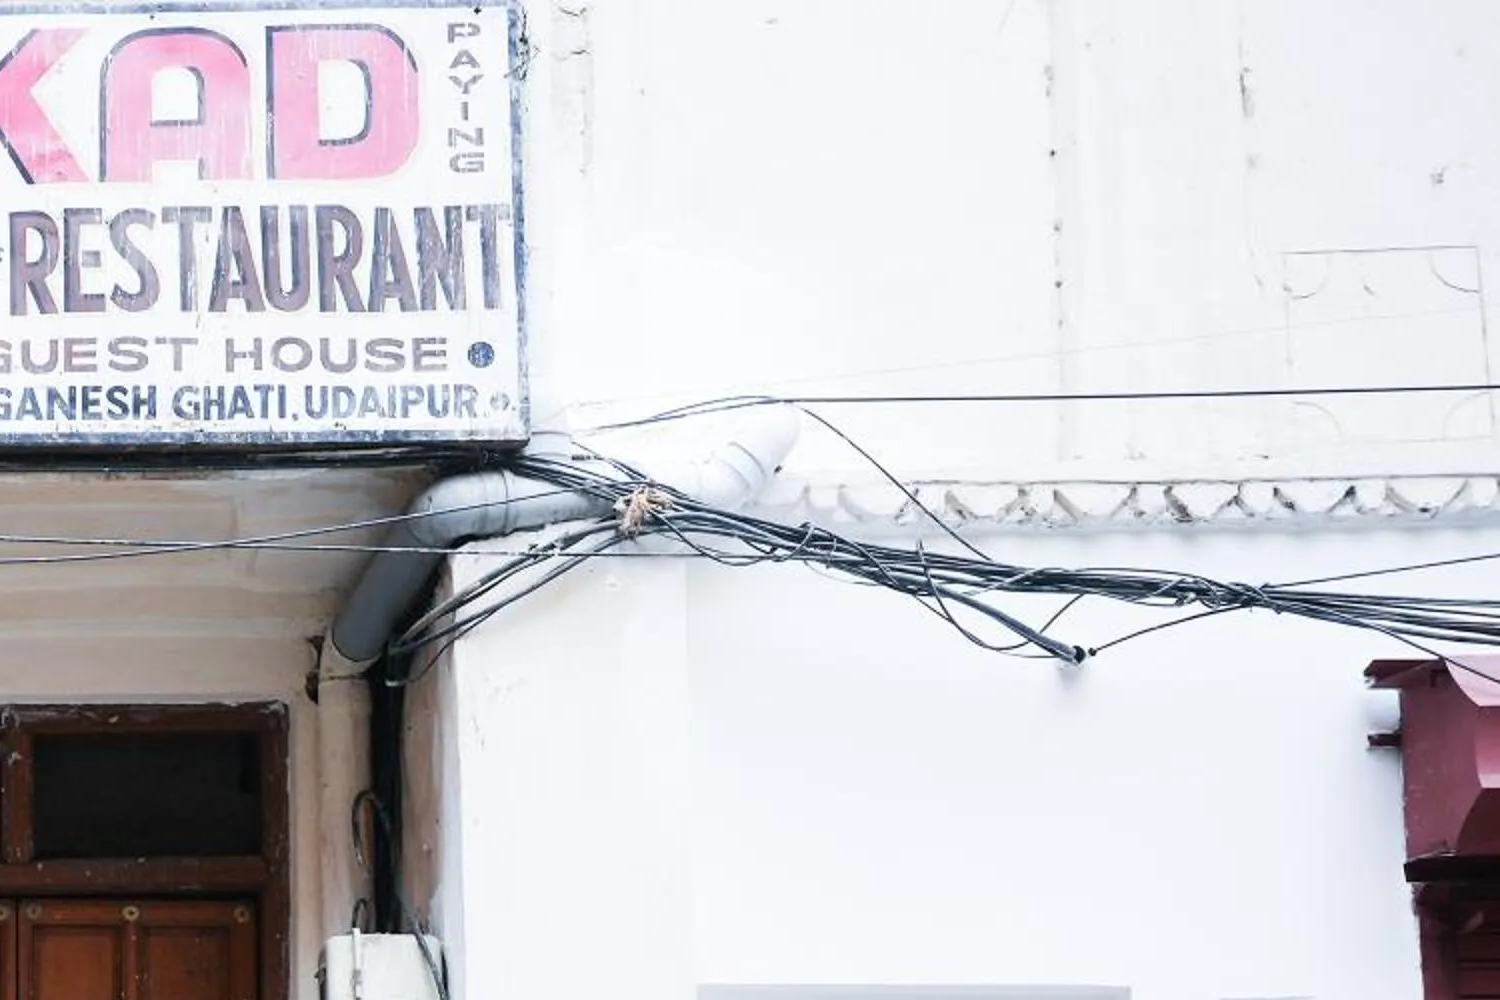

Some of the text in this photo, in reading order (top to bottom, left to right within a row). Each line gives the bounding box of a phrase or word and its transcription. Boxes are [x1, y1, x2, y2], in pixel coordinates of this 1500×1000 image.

[448, 22, 485, 174] PAYING
[9, 203, 510, 316] RESTAURANT
[225, 337, 448, 373] HOUSE
